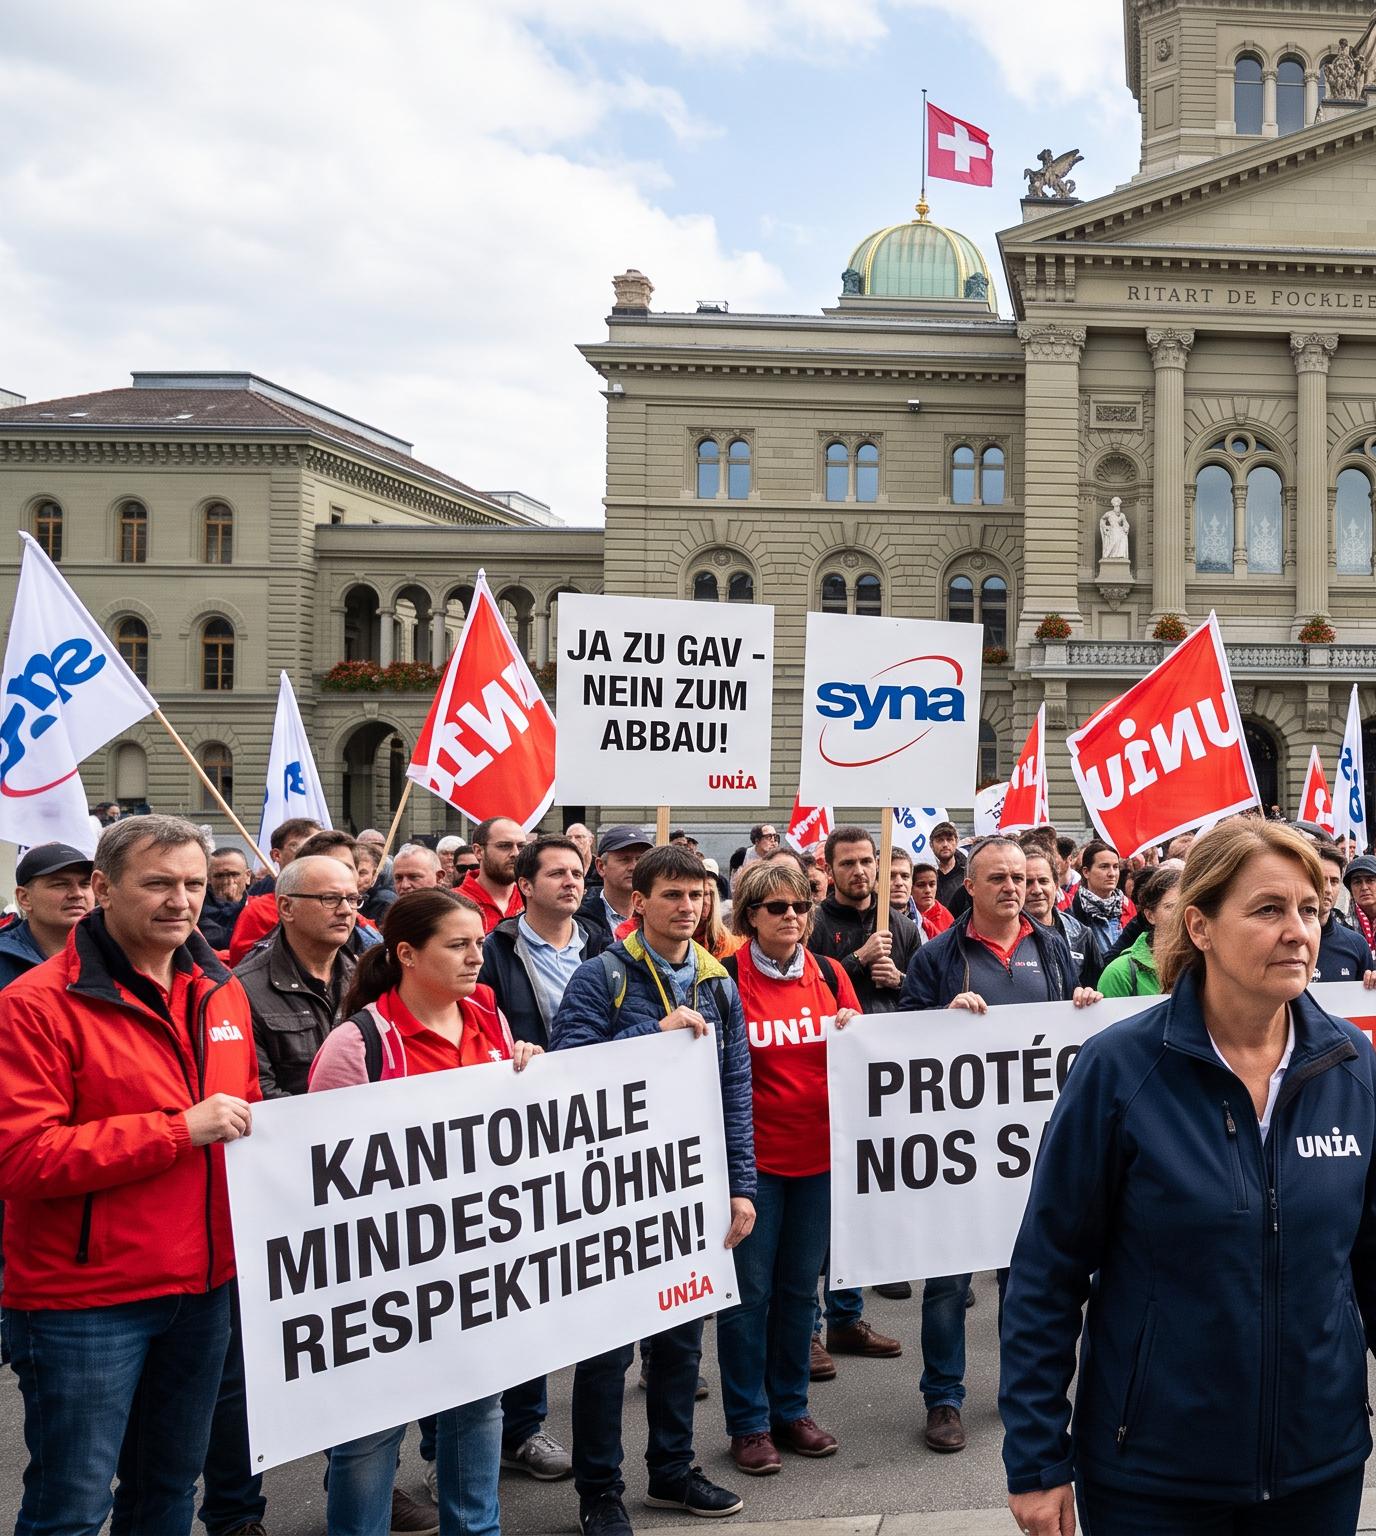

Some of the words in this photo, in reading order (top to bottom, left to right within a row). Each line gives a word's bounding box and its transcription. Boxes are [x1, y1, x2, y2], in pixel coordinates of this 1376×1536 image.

[1127, 285, 1213, 304] RITART
[1227, 289, 1256, 305] DE
[567, 629, 612, 662] JA
[623, 631, 665, 664] ZU
[677, 634, 742, 667] GAV
[583, 674, 663, 708] NEIN
[674, 678, 747, 711] ZUM
[815, 681, 966, 730] syna
[600, 719, 728, 753] ABBAU!
[310, 1080, 649, 1207] KANTONALE
[856, 1129, 977, 1194] NOS
[266, 1135, 704, 1301] MINDESTLÖHNE
[281, 1201, 707, 1382] RESPEKTIEREN!
